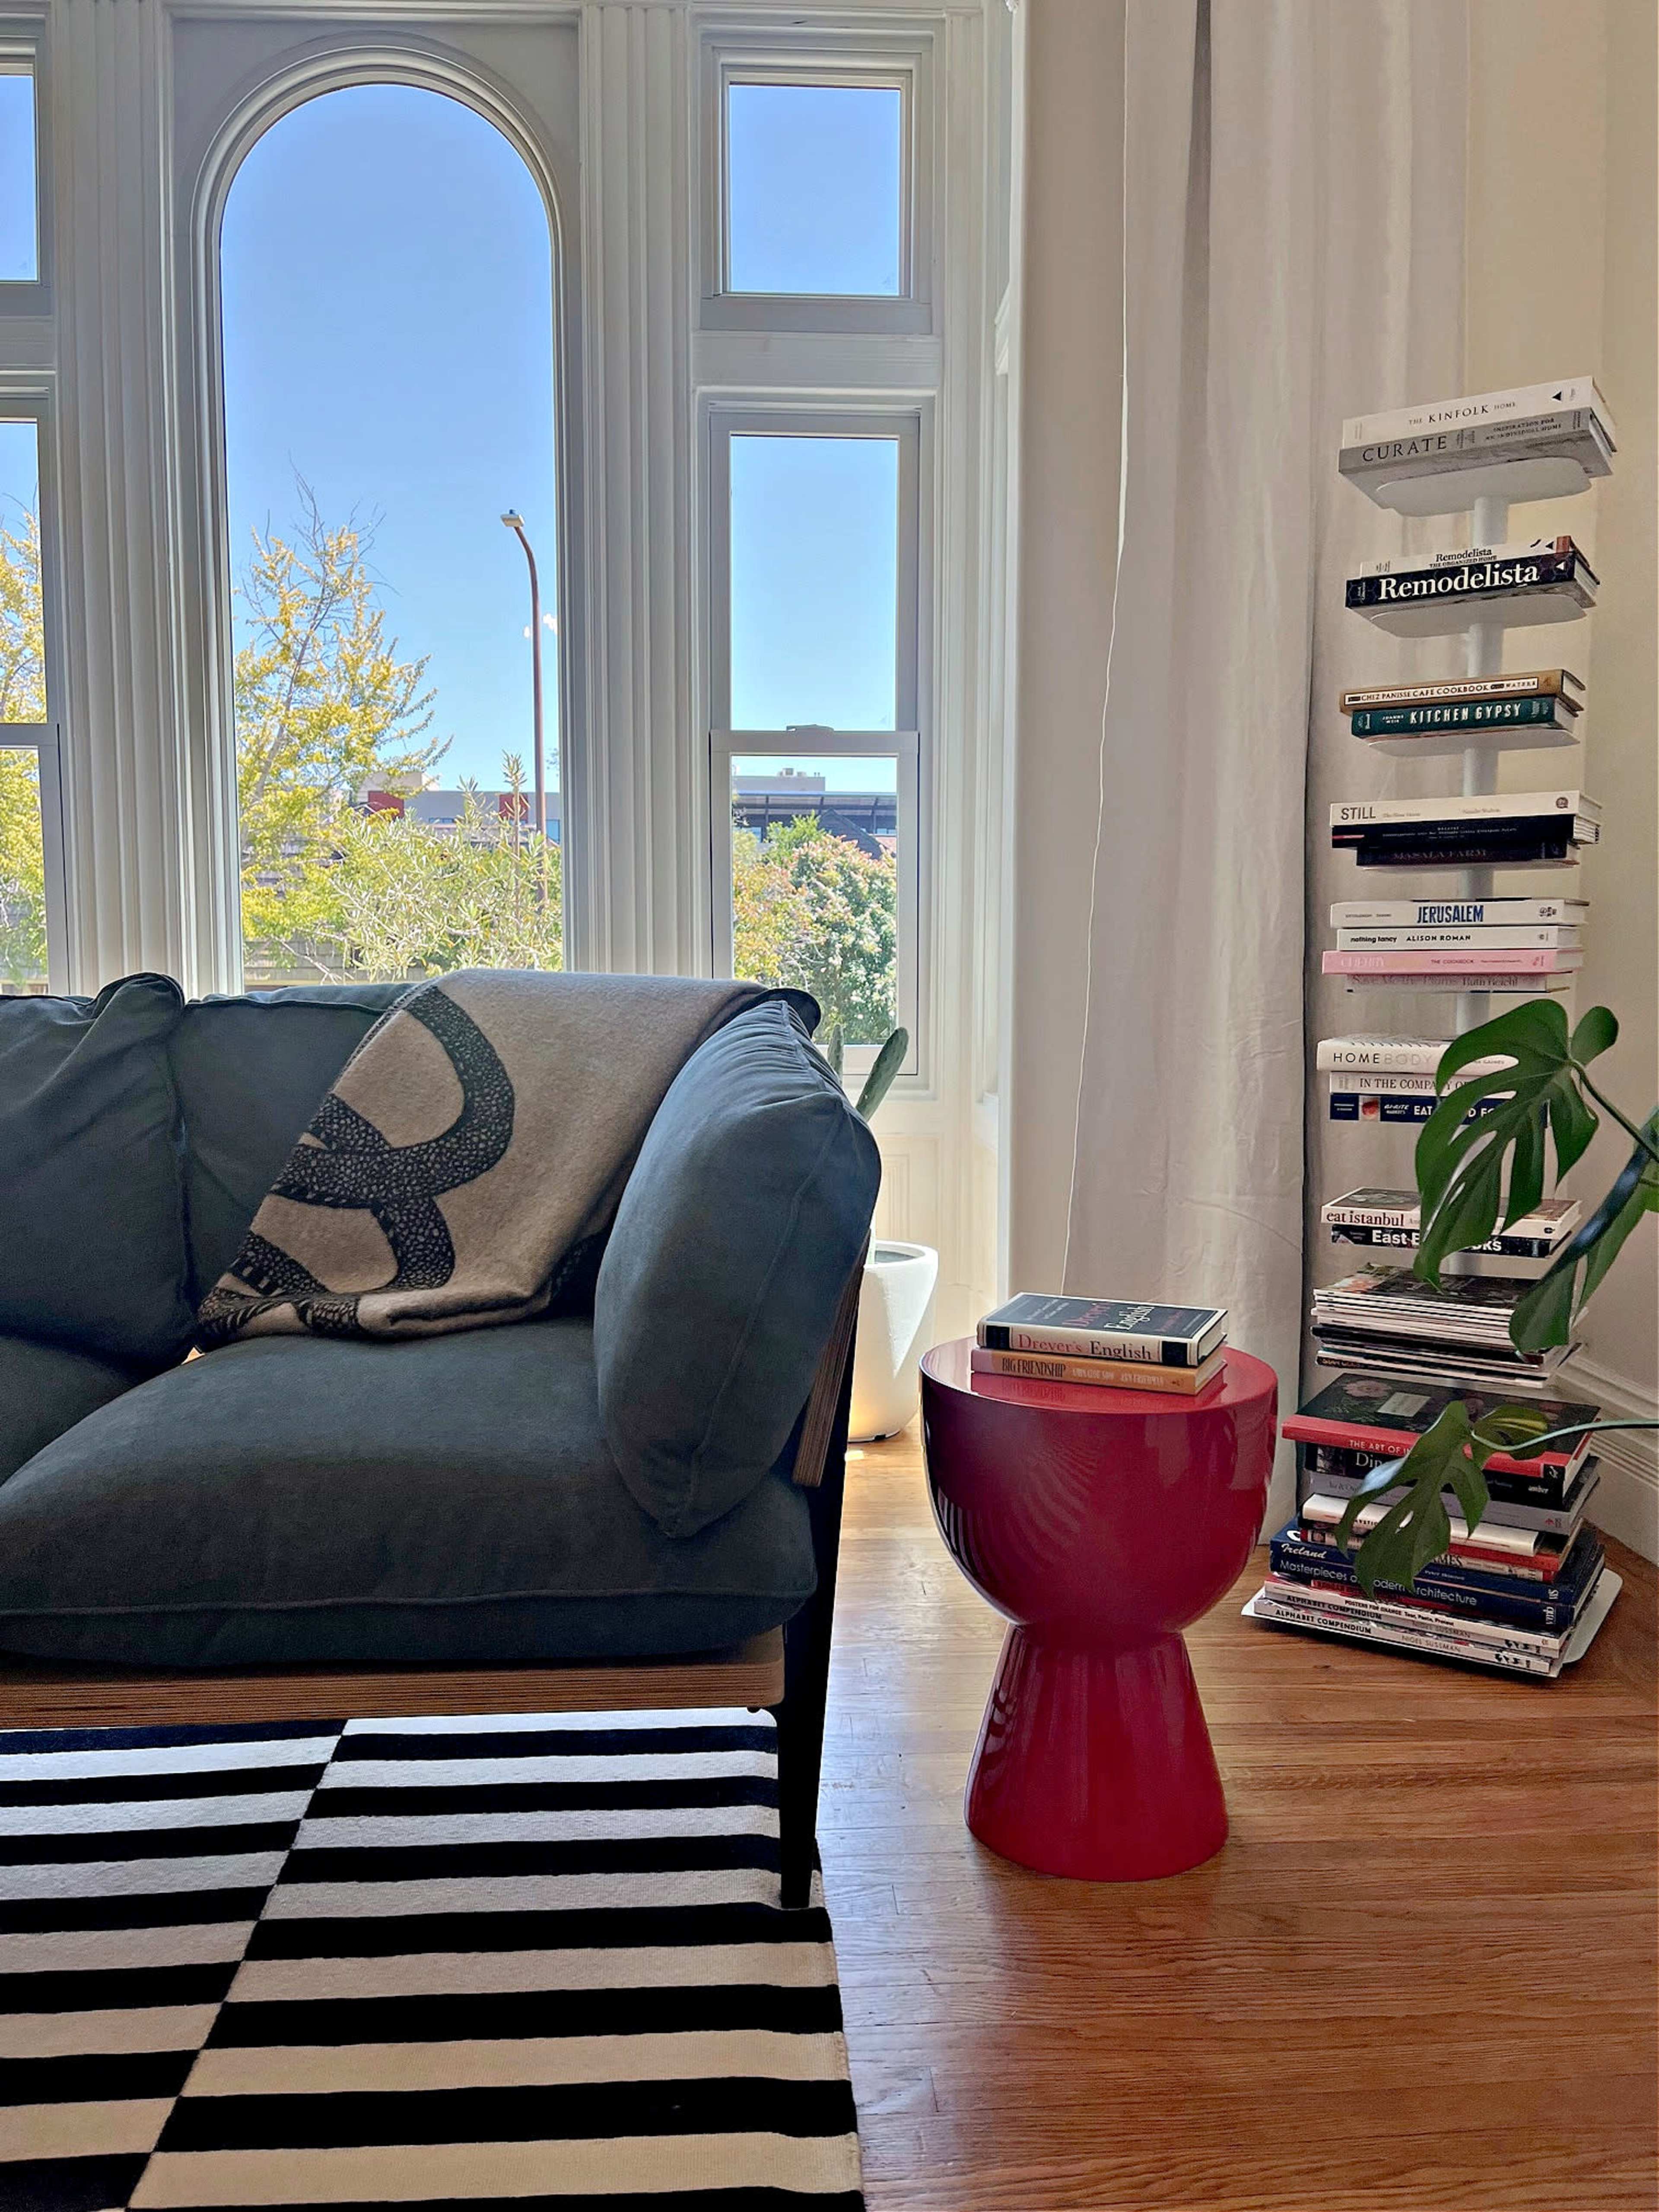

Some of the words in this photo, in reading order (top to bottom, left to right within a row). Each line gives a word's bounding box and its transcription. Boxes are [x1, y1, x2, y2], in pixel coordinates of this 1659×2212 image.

[1428, 404, 1489, 423] KINFOLK
[1494, 401, 1516, 410] HOME
[1362, 435, 1447, 462] CURATE
[1436, 549, 1493, 562] Remodelista
[1378, 563, 1540, 600] Remodelista
[1382, 691, 1411, 699] PANISSE
[1437, 684, 1489, 695] COOKBOOK
[1410, 706, 1469, 725] KITCHEN
[1475, 702, 1521, 720] GYPSY
[1341, 806, 1376, 820] STILL
[1417, 905, 1484, 924] JERUSALEM
[1359, 1078, 1371, 1088] IN
[1375, 1078, 1396, 1089] THE
[1399, 1079, 1451, 1090] COMPAY
[1414, 1106, 1433, 1116] EAT
[1326, 1211, 1347, 1223] eat
[1349, 1211, 1404, 1227] istanbul
[1372, 1229, 1408, 1245] East
[1089, 1340, 1152, 1361] English
[1002, 1357, 1015, 1372] BIG
[1017, 1359, 1066, 1378] FRIENDSHIP
[1350, 1440, 1366, 1448] THE
[1369, 1443, 1385, 1452] ART
[1387, 1445, 1400, 1453] OF
[1281, 1543, 1327, 1559] Ireland
[1280, 1559, 1348, 1581] Masterpieces
[1372, 1579, 1406, 1592] odern
[1415, 1586, 1477, 1606] rchitecture
[1286, 1595, 1325, 1609] ALPHABET
[1327, 1603, 1382, 1620] COMPENDIUM
[1344, 1600, 1368, 1608] POSTERS
[1275, 1609, 1314, 1622] ALPHABET
[1317, 1617, 1372, 1634] COMPENDIUM
